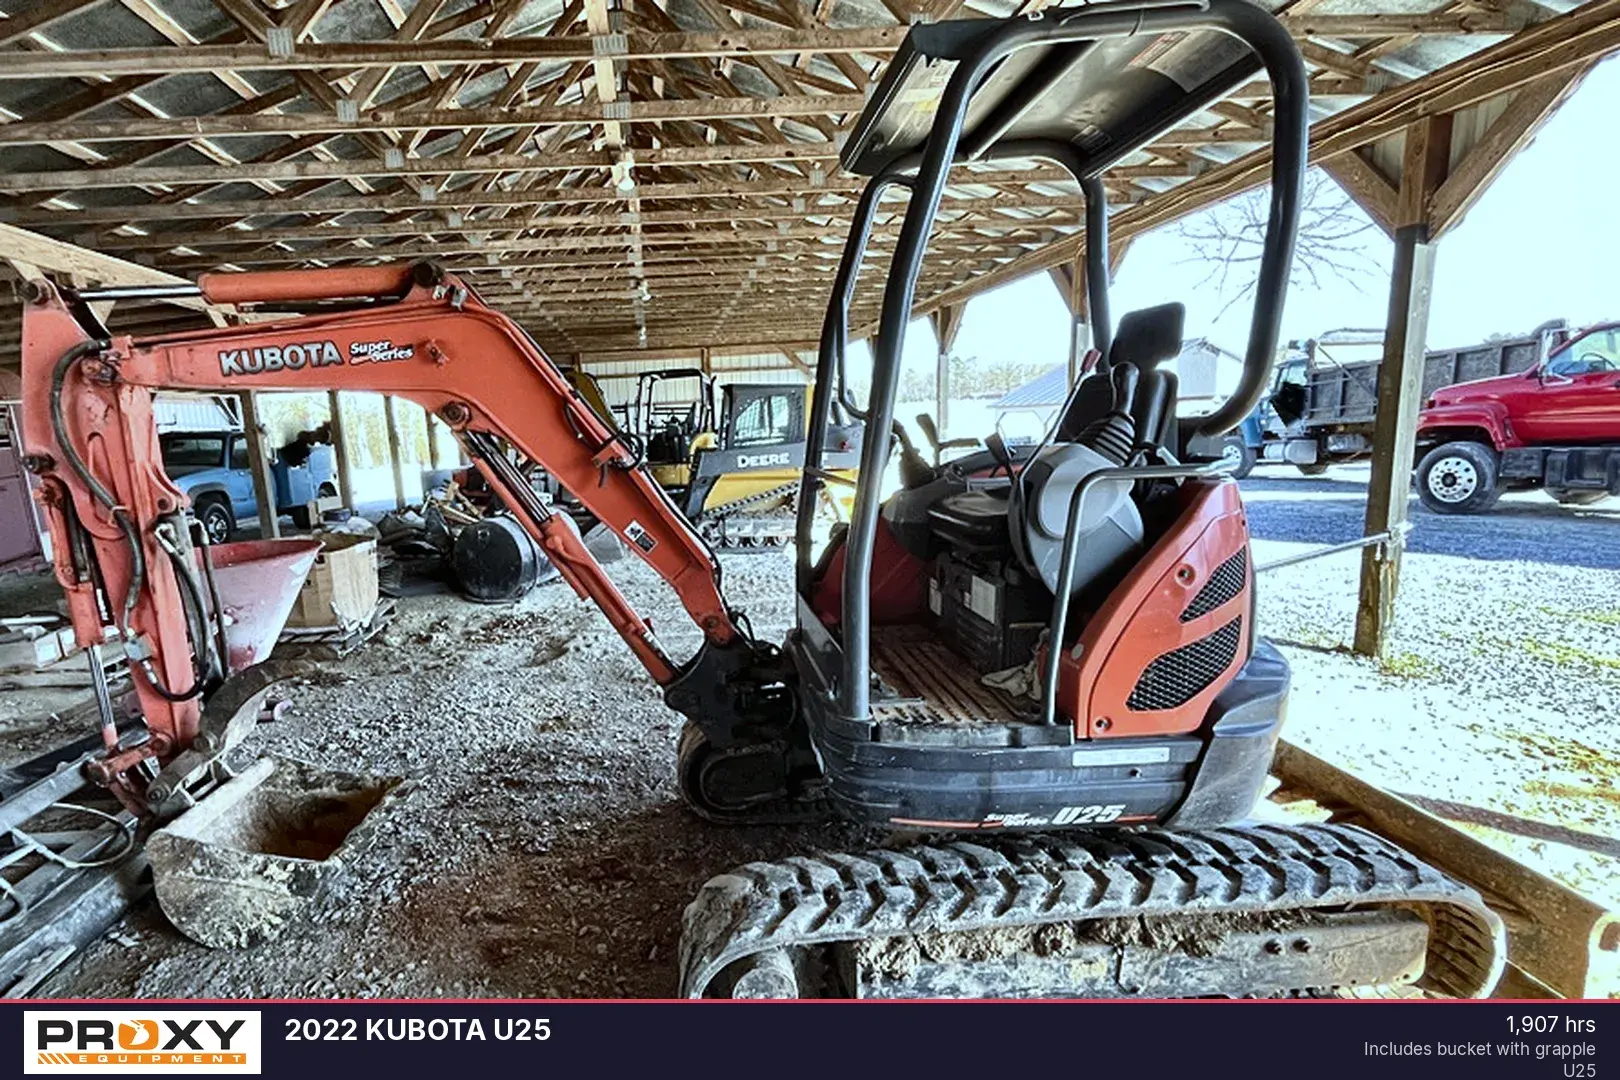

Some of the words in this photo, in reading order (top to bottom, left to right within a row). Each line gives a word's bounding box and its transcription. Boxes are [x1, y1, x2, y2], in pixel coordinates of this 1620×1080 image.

[350, 341, 390, 356] Super
[219, 341, 342, 376] KUBOTA
[737, 453, 789, 468] DEERE
[1052, 805, 1125, 825] U25
